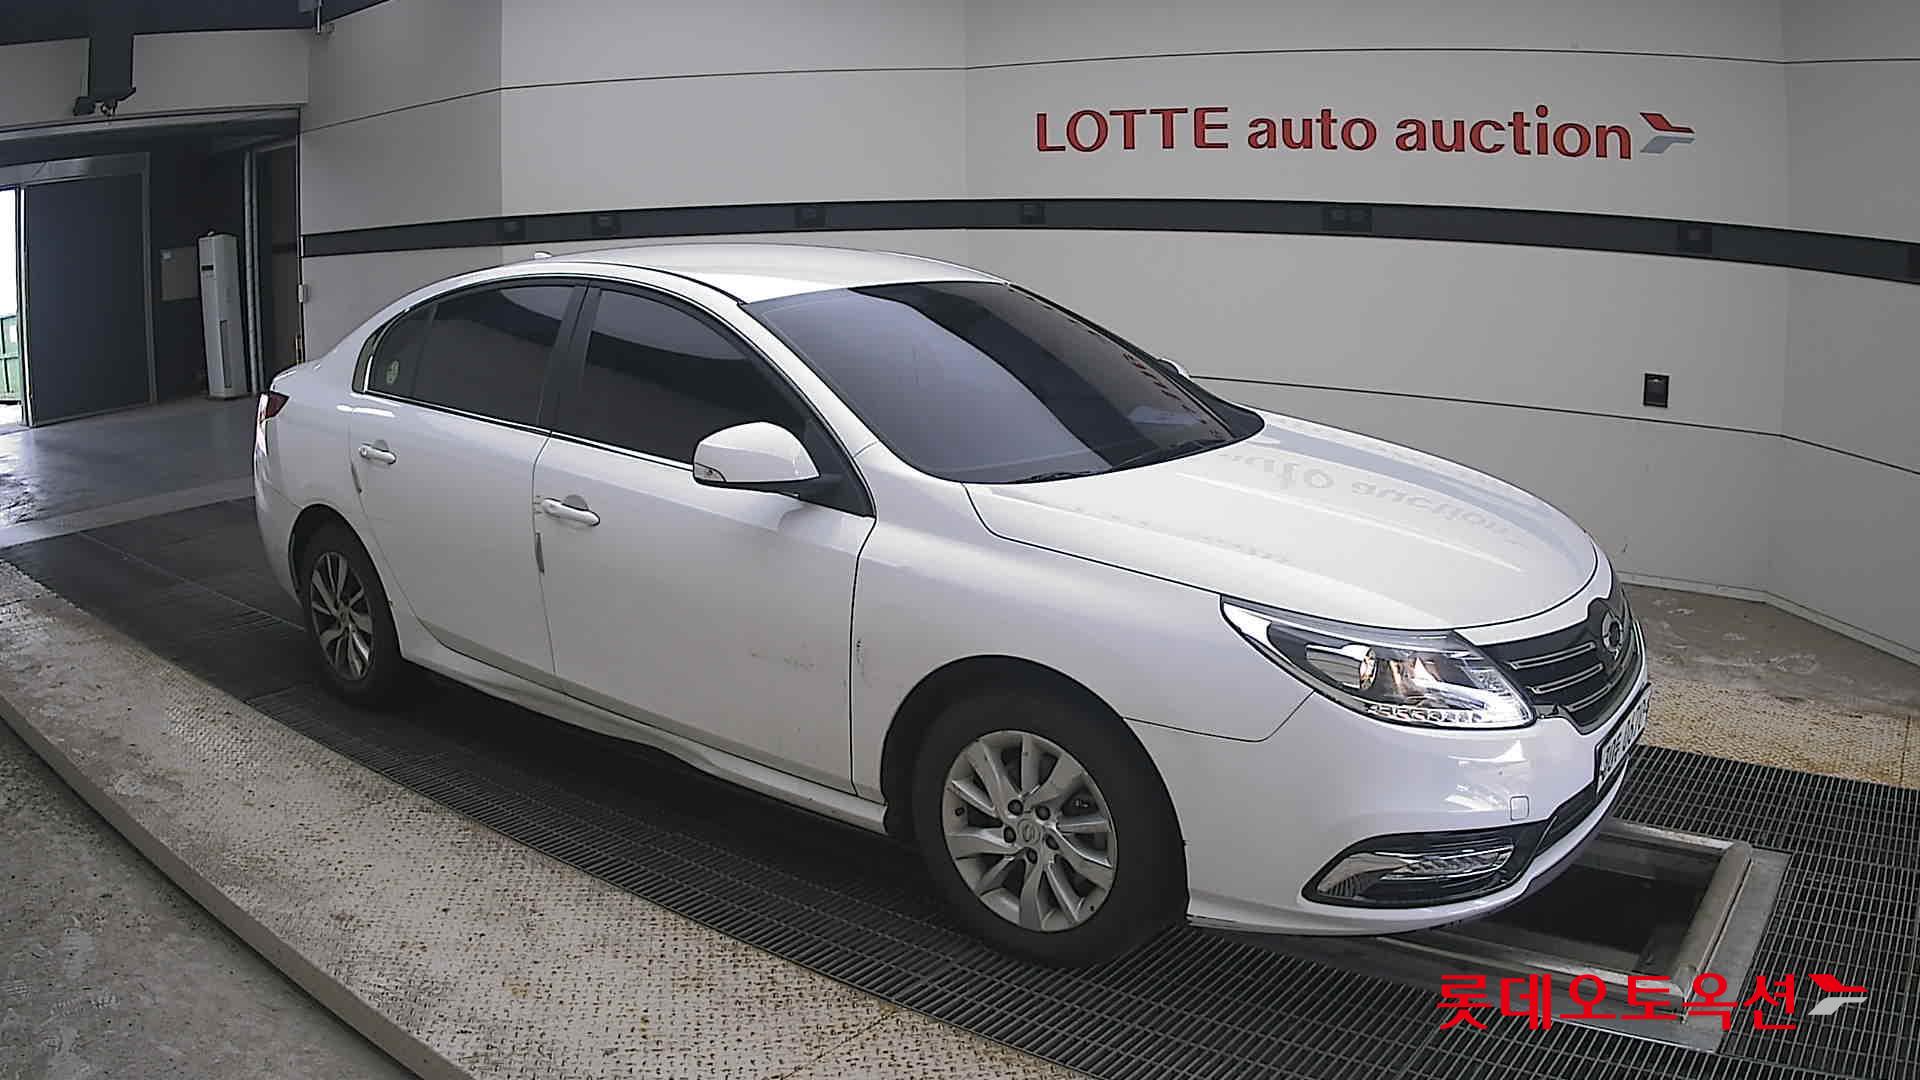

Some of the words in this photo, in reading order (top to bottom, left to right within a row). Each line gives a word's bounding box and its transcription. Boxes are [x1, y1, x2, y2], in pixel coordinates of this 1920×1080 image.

[1036, 107, 1229, 152] LOTTE
[1248, 109, 1377, 151] auto
[1395, 104, 1632, 160] auction
